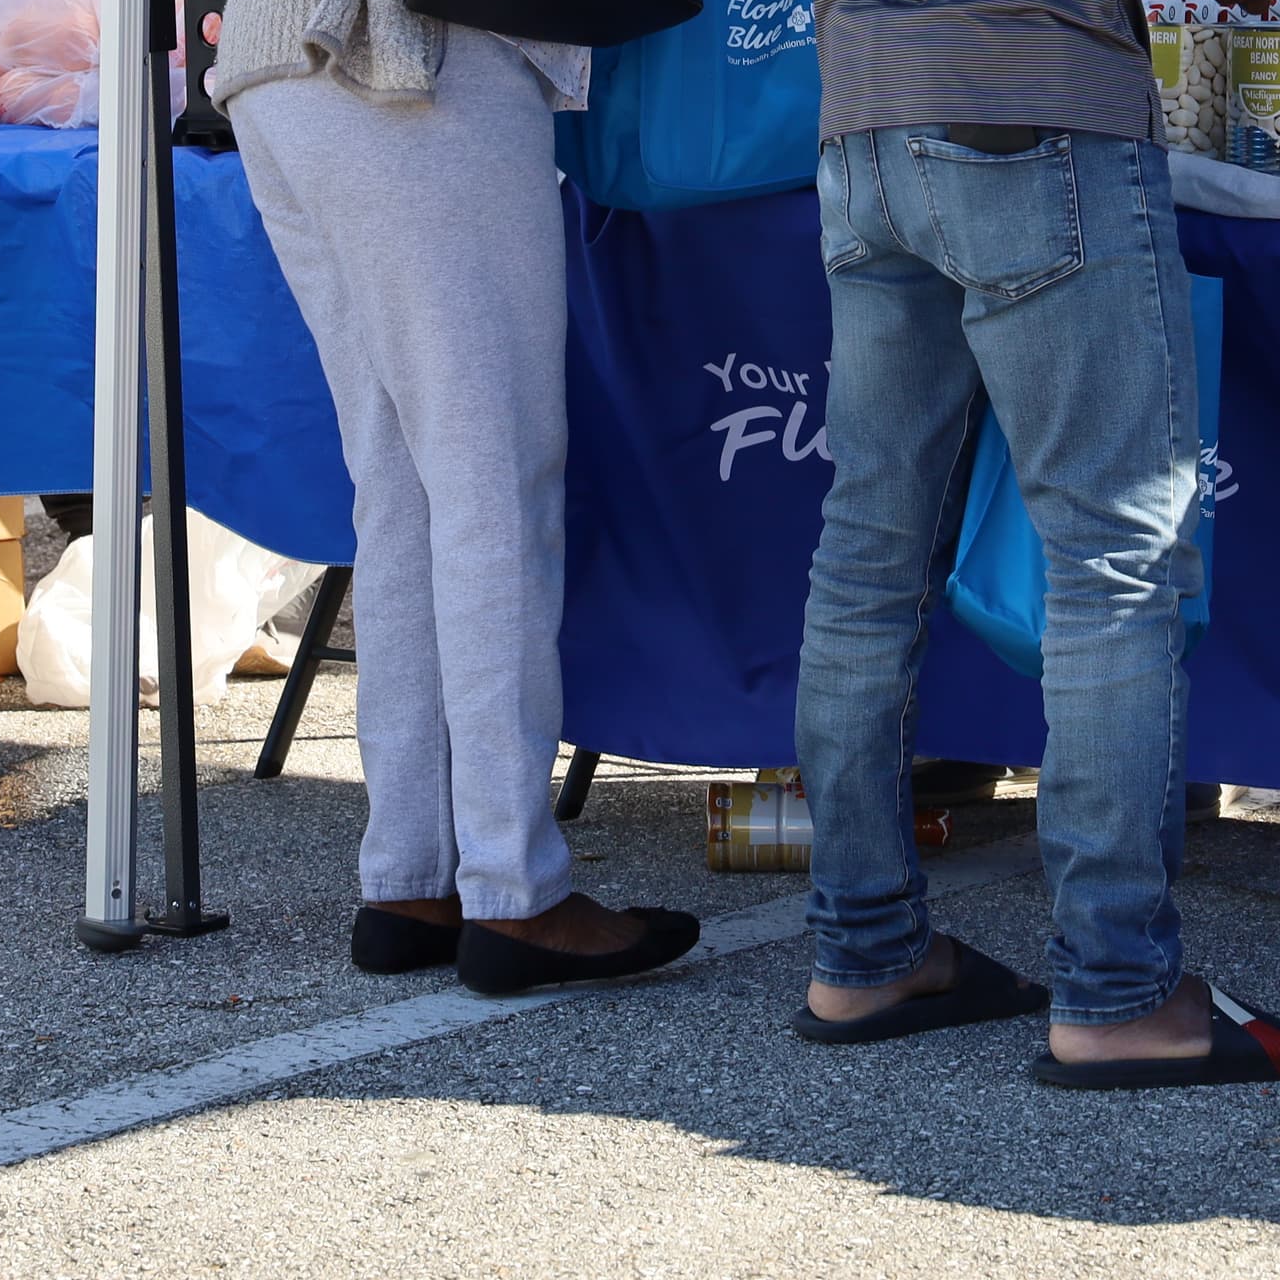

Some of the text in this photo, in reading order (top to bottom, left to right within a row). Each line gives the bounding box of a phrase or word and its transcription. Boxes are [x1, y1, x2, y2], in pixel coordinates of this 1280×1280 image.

[726, 23, 783, 50] Blue
[1150, 32, 1177, 45] HERN
[1232, 35, 1253, 49] GREAT
[1250, 51, 1280, 64] BEANS
[1250, 71, 1278, 81] FANCY
[1250, 102, 1274, 113] Made
[702, 352, 810, 396] Your
